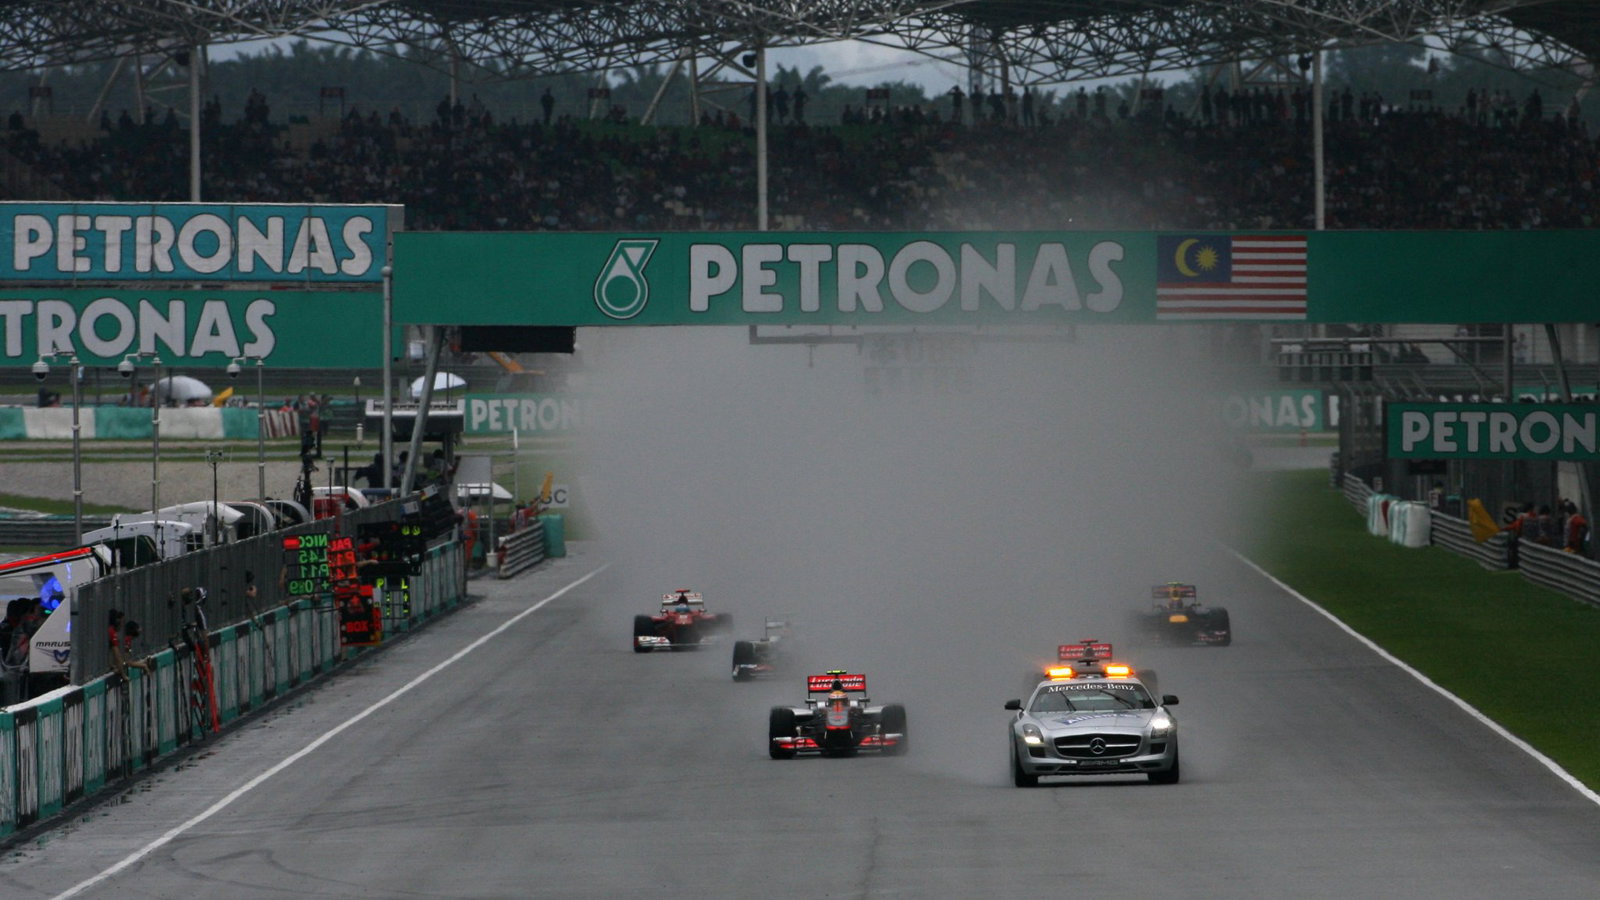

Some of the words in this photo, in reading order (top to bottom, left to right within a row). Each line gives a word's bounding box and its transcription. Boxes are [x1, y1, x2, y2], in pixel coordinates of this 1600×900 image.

[13, 213, 373, 276] PETRONAS
[689, 240, 1125, 313] PETRONAS
[0, 297, 276, 359] TRONAS
[1048, 683, 1135, 693] Mercedes-Benz
